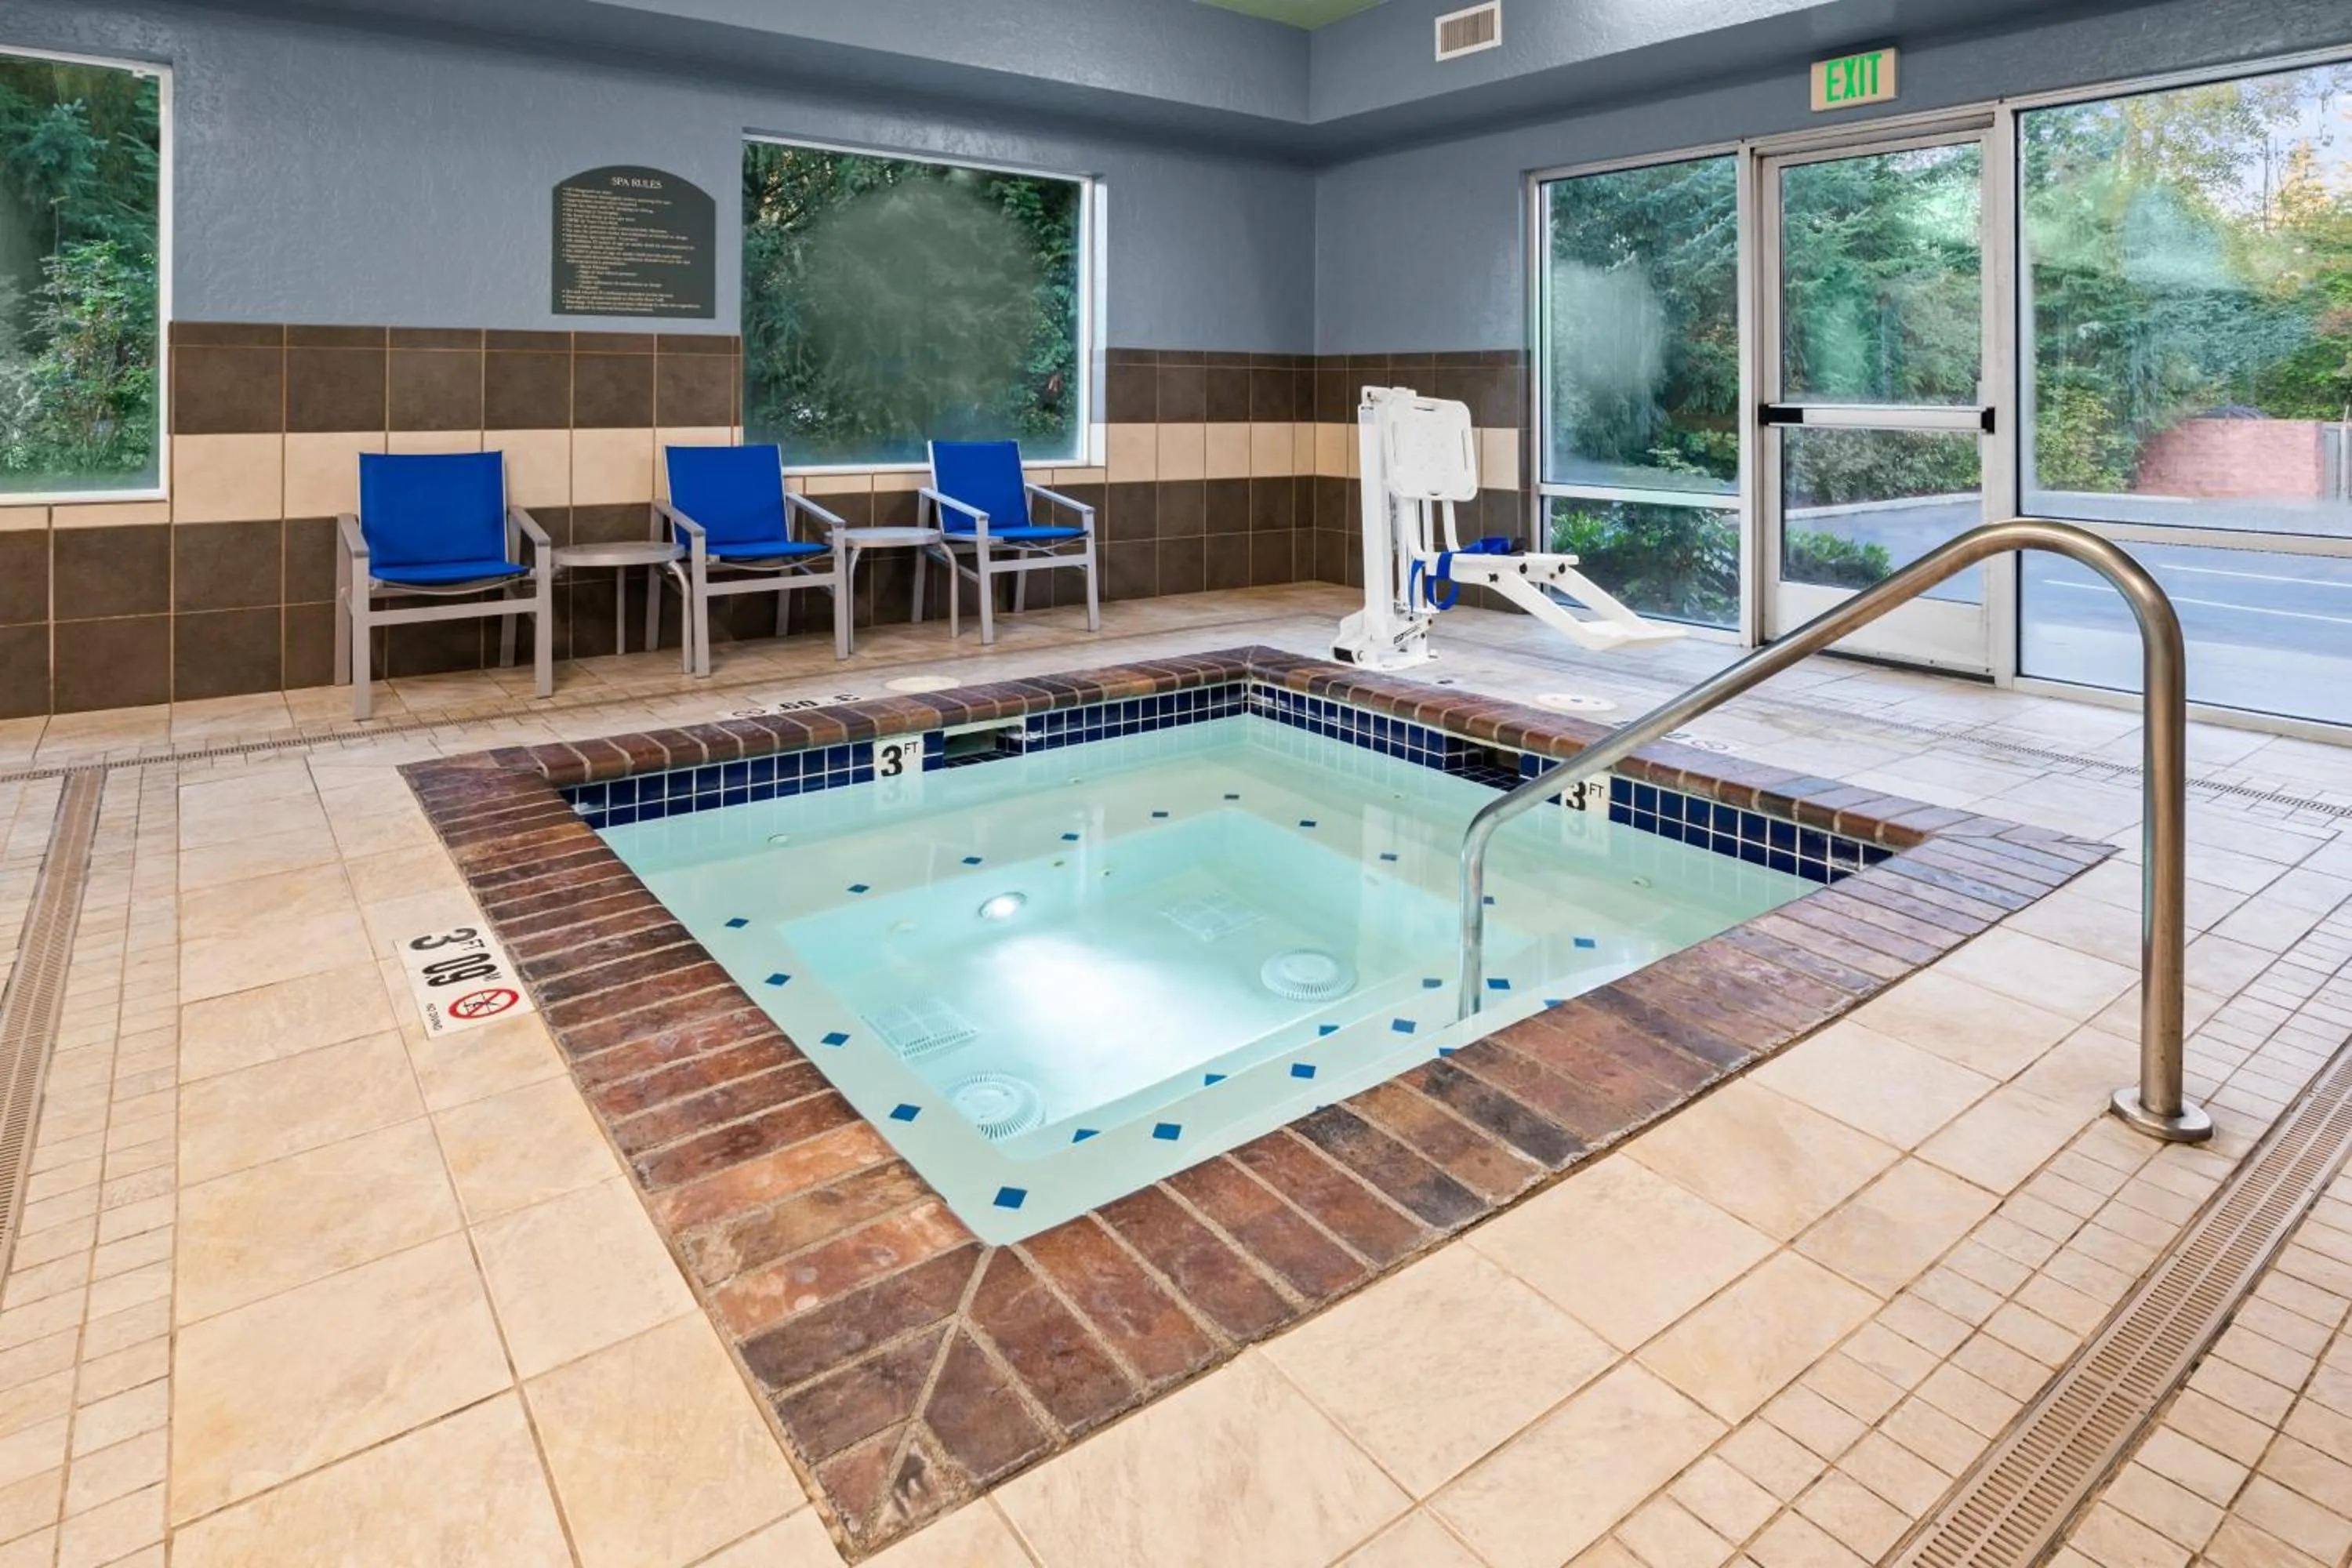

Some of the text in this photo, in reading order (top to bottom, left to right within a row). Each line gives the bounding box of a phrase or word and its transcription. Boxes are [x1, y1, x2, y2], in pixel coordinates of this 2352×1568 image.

[1826, 52, 1882, 103] EXIT
[610, 175, 663, 189] SPA RULES
[880, 741, 919, 778] 3 FT
[1566, 780, 1605, 811] 3 FT
[409, 927, 477, 950] 3
